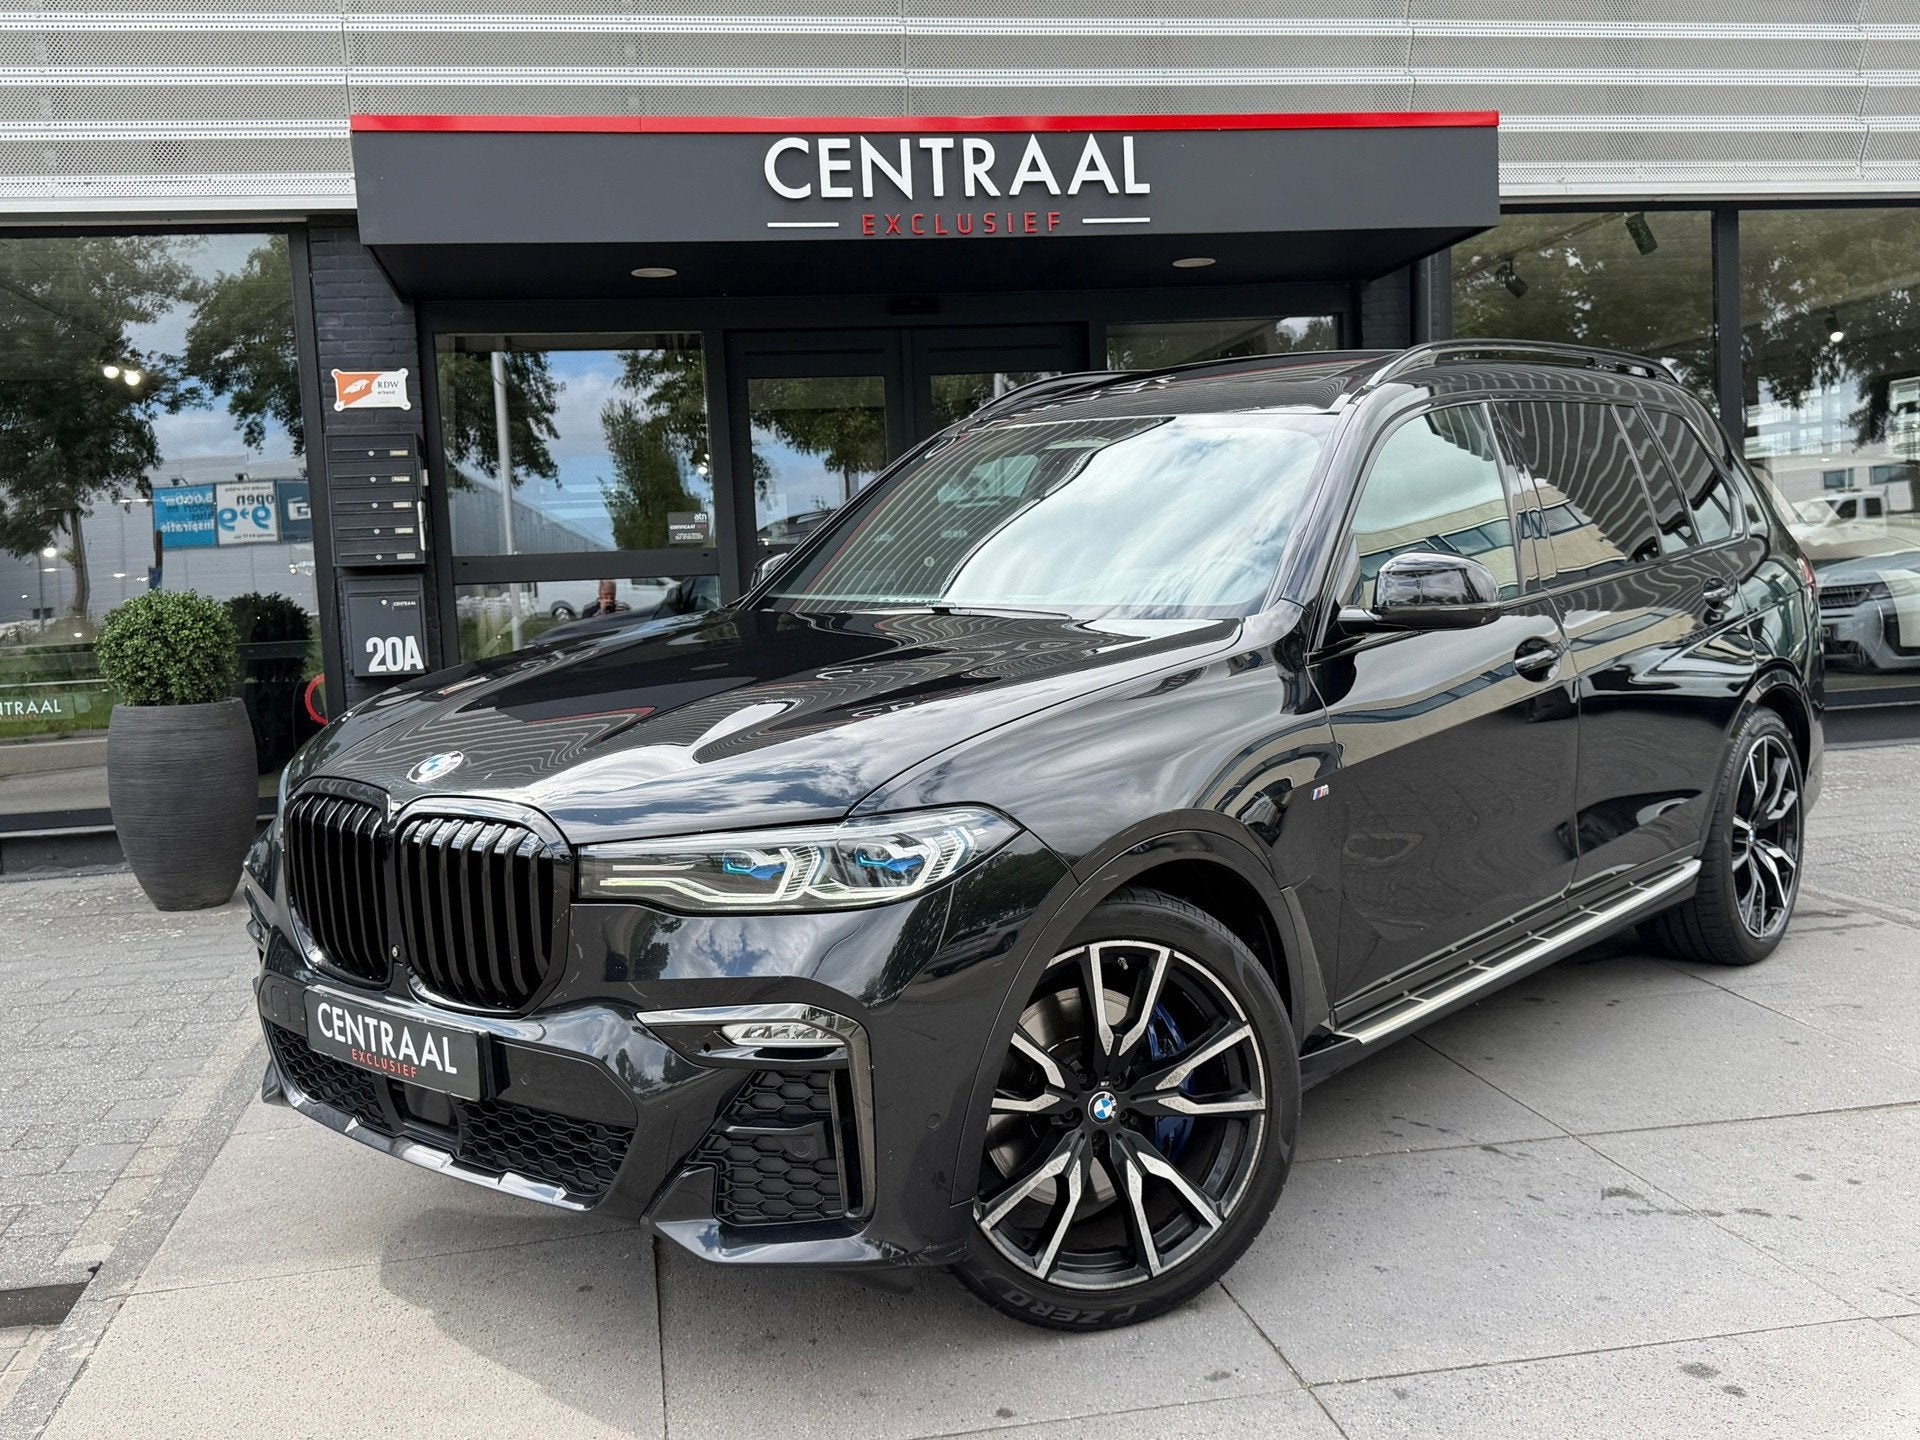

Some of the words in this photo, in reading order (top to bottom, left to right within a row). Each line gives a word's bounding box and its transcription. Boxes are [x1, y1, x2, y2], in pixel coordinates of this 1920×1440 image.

[763, 133, 1151, 200] CENTRAAL
[861, 211, 1062, 236] EXCLUSIEF
[366, 635, 424, 672] 20A
[317, 1002, 457, 1075] CENTRAAL
[351, 1048, 417, 1078] EXCLUSIEF
[1002, 1289, 1099, 1323] ZERO
